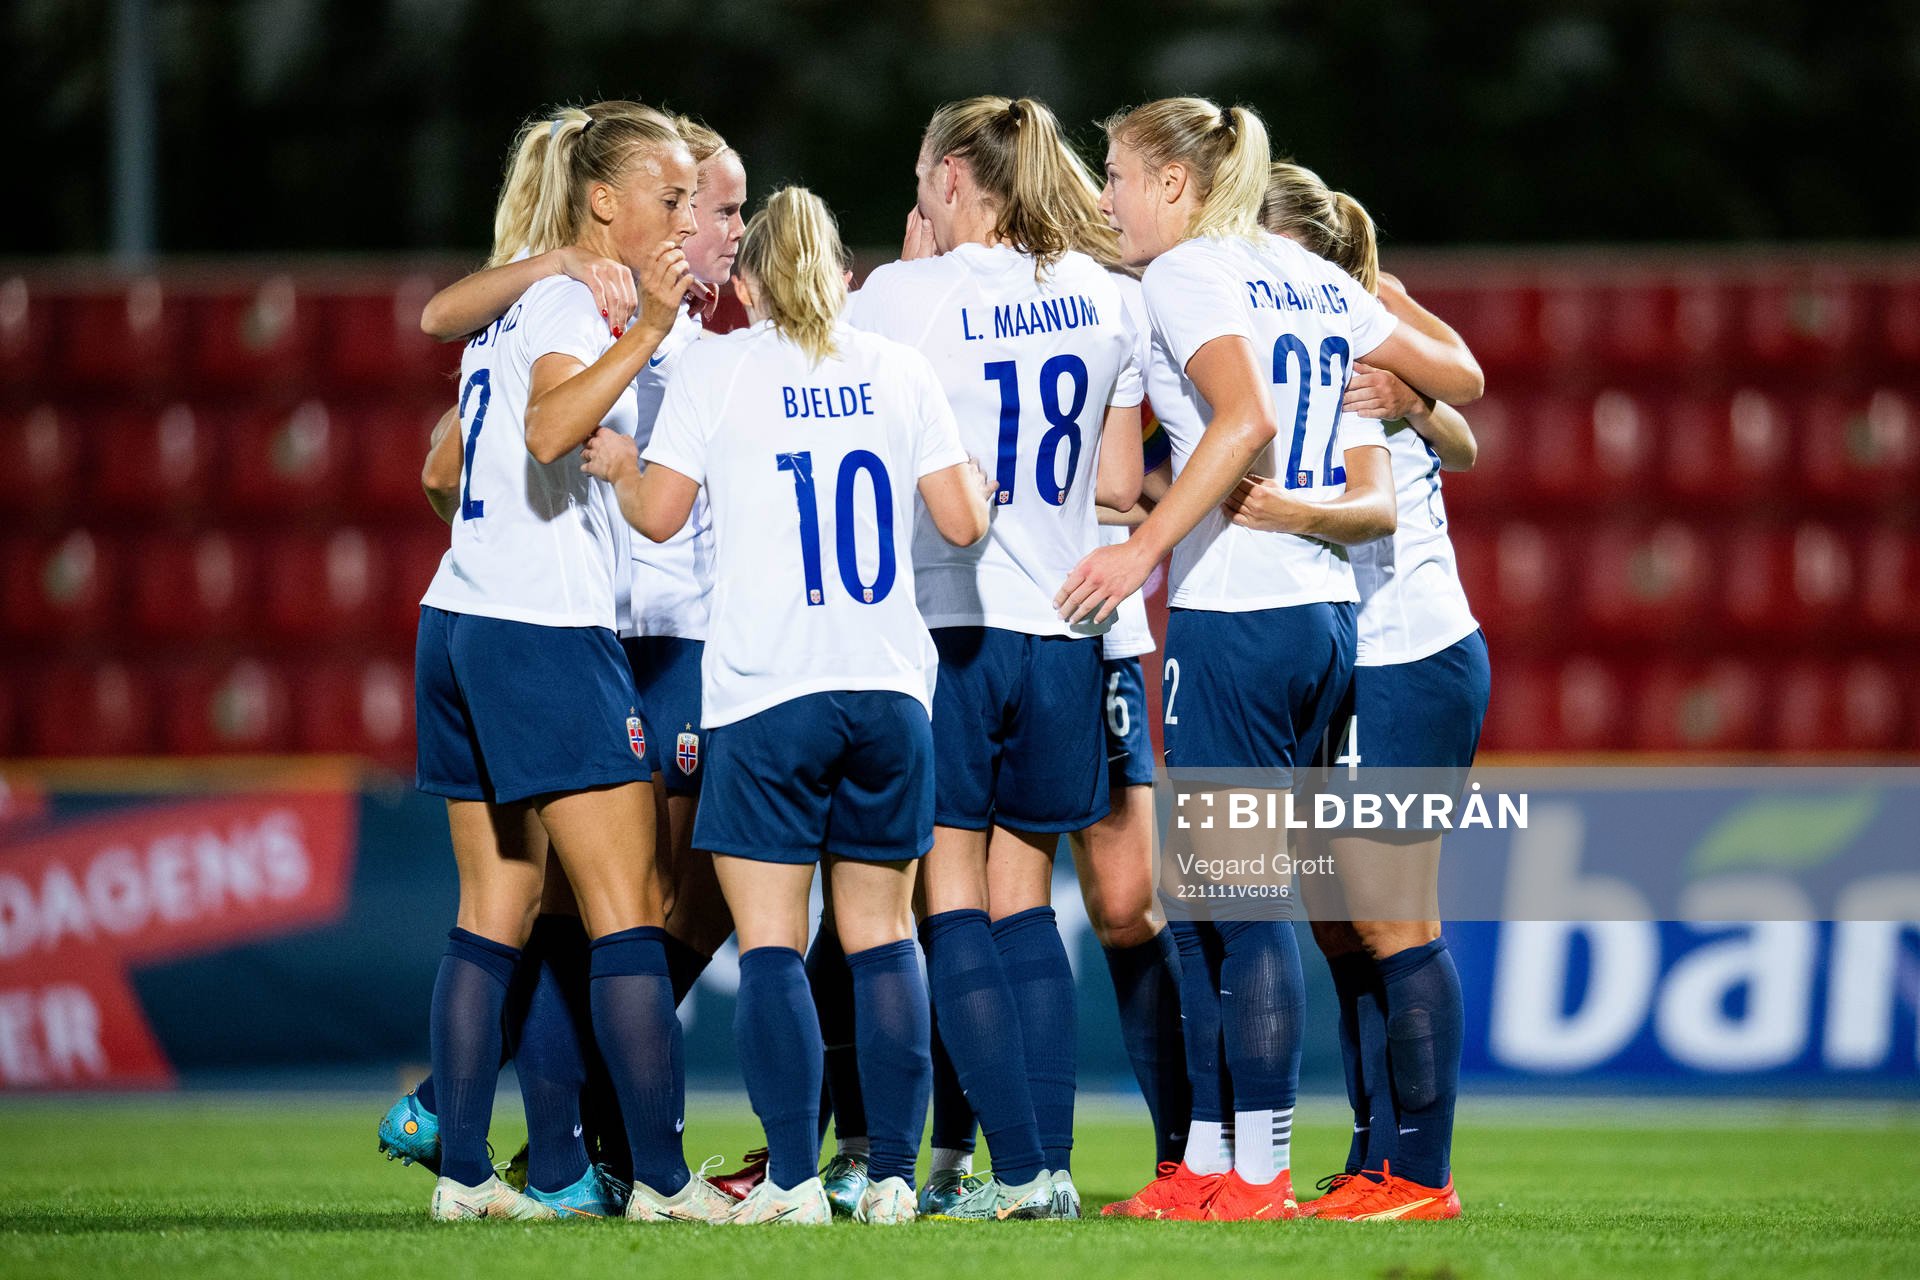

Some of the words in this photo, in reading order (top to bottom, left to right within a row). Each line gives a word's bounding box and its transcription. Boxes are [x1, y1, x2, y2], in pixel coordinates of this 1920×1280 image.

[962, 307, 984, 341] L.
[994, 294, 1100, 339] MAANUM
[459, 367, 491, 522] 2
[782, 382, 875, 419] BJELDE
[983, 353, 1089, 507] 18
[1272, 332, 1351, 490] 22
[775, 449, 897, 607] 10
[1106, 671, 1130, 737] 6
[1162, 657, 1180, 725] 2
